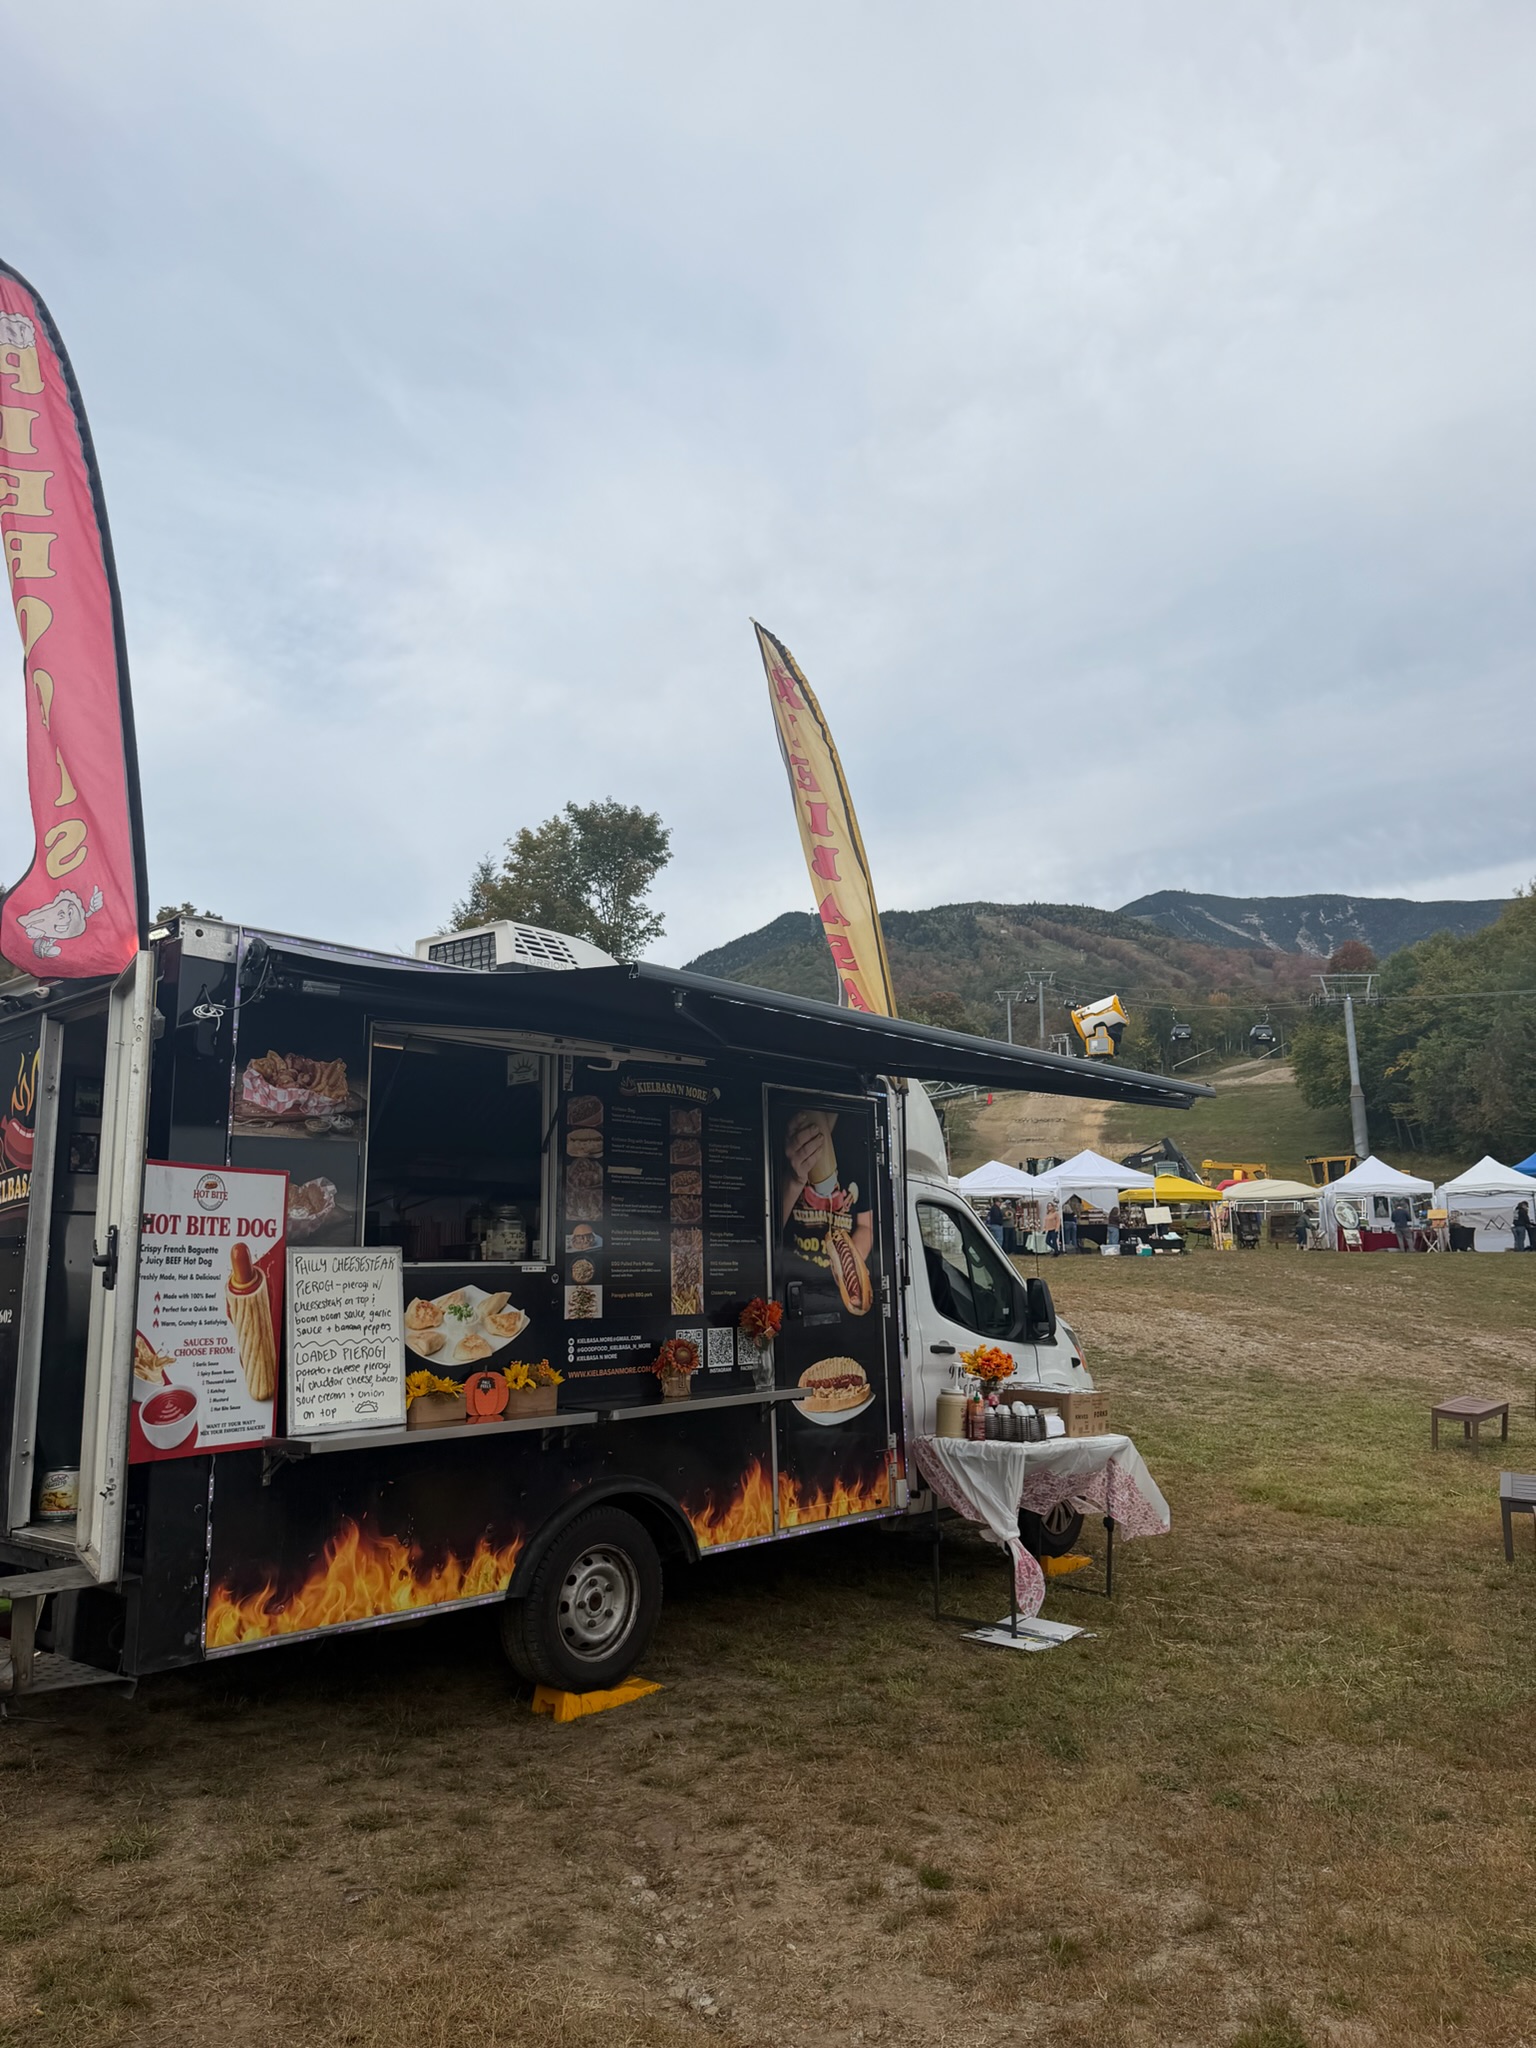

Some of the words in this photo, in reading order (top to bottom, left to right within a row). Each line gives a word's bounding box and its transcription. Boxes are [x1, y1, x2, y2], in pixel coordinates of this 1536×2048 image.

[685, 1085, 708, 1101] MORE
[193, 1190, 210, 1199] HOT
[211, 1190, 228, 1200] BITE
[142, 1213, 182, 1235] HOT
[186, 1215, 230, 1236] BITE
[236, 1218, 278, 1238] DOG
[140, 1244, 162, 1254] Crispy
[163, 1244, 186, 1254] French
[188, 1246, 219, 1256] Baguette
[146, 1256, 163, 1267] Juicy
[165, 1256, 182, 1264] BEEF
[183, 1257, 197, 1265] Hot
[198, 1257, 212, 1267] Dog
[295, 1256, 327, 1274] PHILLY
[332, 1255, 396, 1273] CHEESESTEAK
[295, 1315, 318, 1325] boom
[320, 1312, 341, 1320] boom
[369, 1308, 392, 1322] garlic
[296, 1326, 322, 1337] sauce
[363, 1323, 391, 1336] peppers
[183, 1338, 214, 1347] SAUCES
[216, 1337, 228, 1345] TO
[174, 1348, 208, 1357] CHOOSE
[209, 1346, 236, 1355] FROM:
[296, 1350, 337, 1365] LOADED
[343, 1346, 386, 1360] PIEROGI
[364, 1361, 391, 1375] pierogi
[296, 1395, 317, 1407] sour
[318, 1391, 346, 1404] cream
[358, 1390, 384, 1398] onion
[303, 1411, 314, 1420] on
[320, 1408, 337, 1418] top
